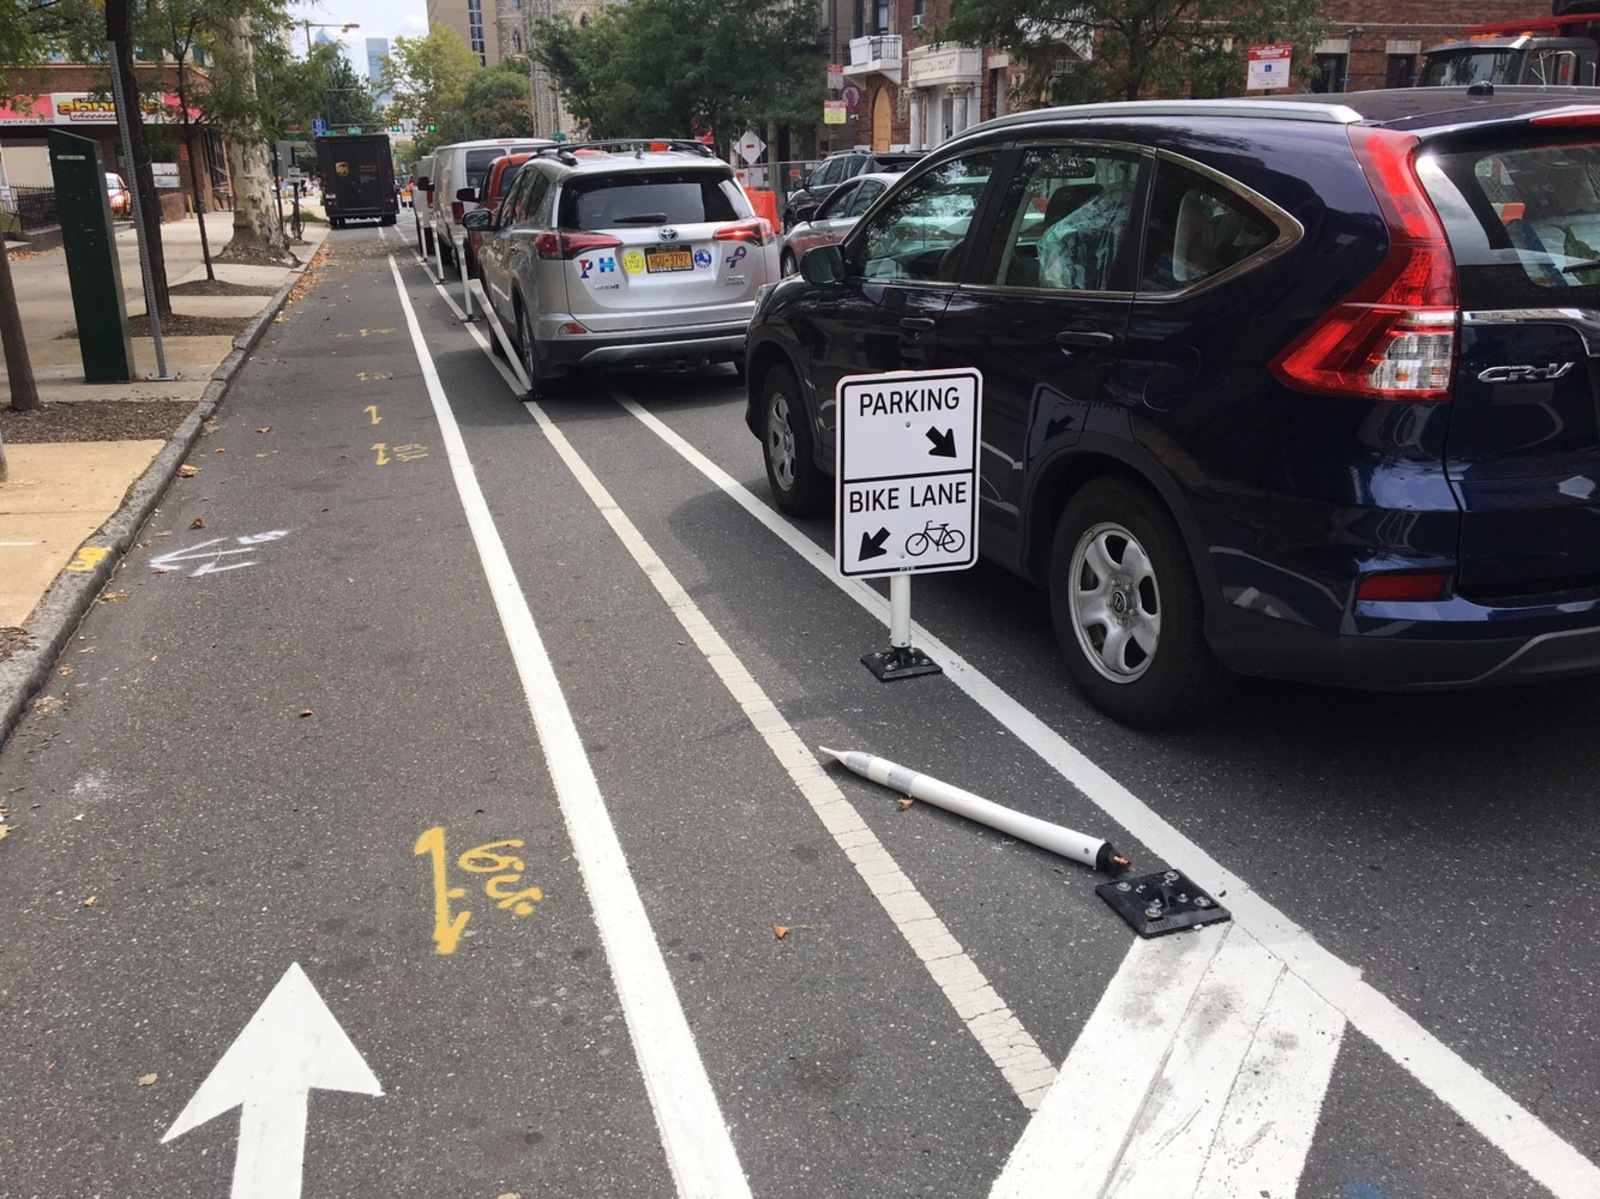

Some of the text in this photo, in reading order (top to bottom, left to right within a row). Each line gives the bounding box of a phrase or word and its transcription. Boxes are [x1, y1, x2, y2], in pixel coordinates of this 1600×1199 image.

[859, 386, 960, 417] PARKING
[849, 481, 967, 514] BIKE LANE
